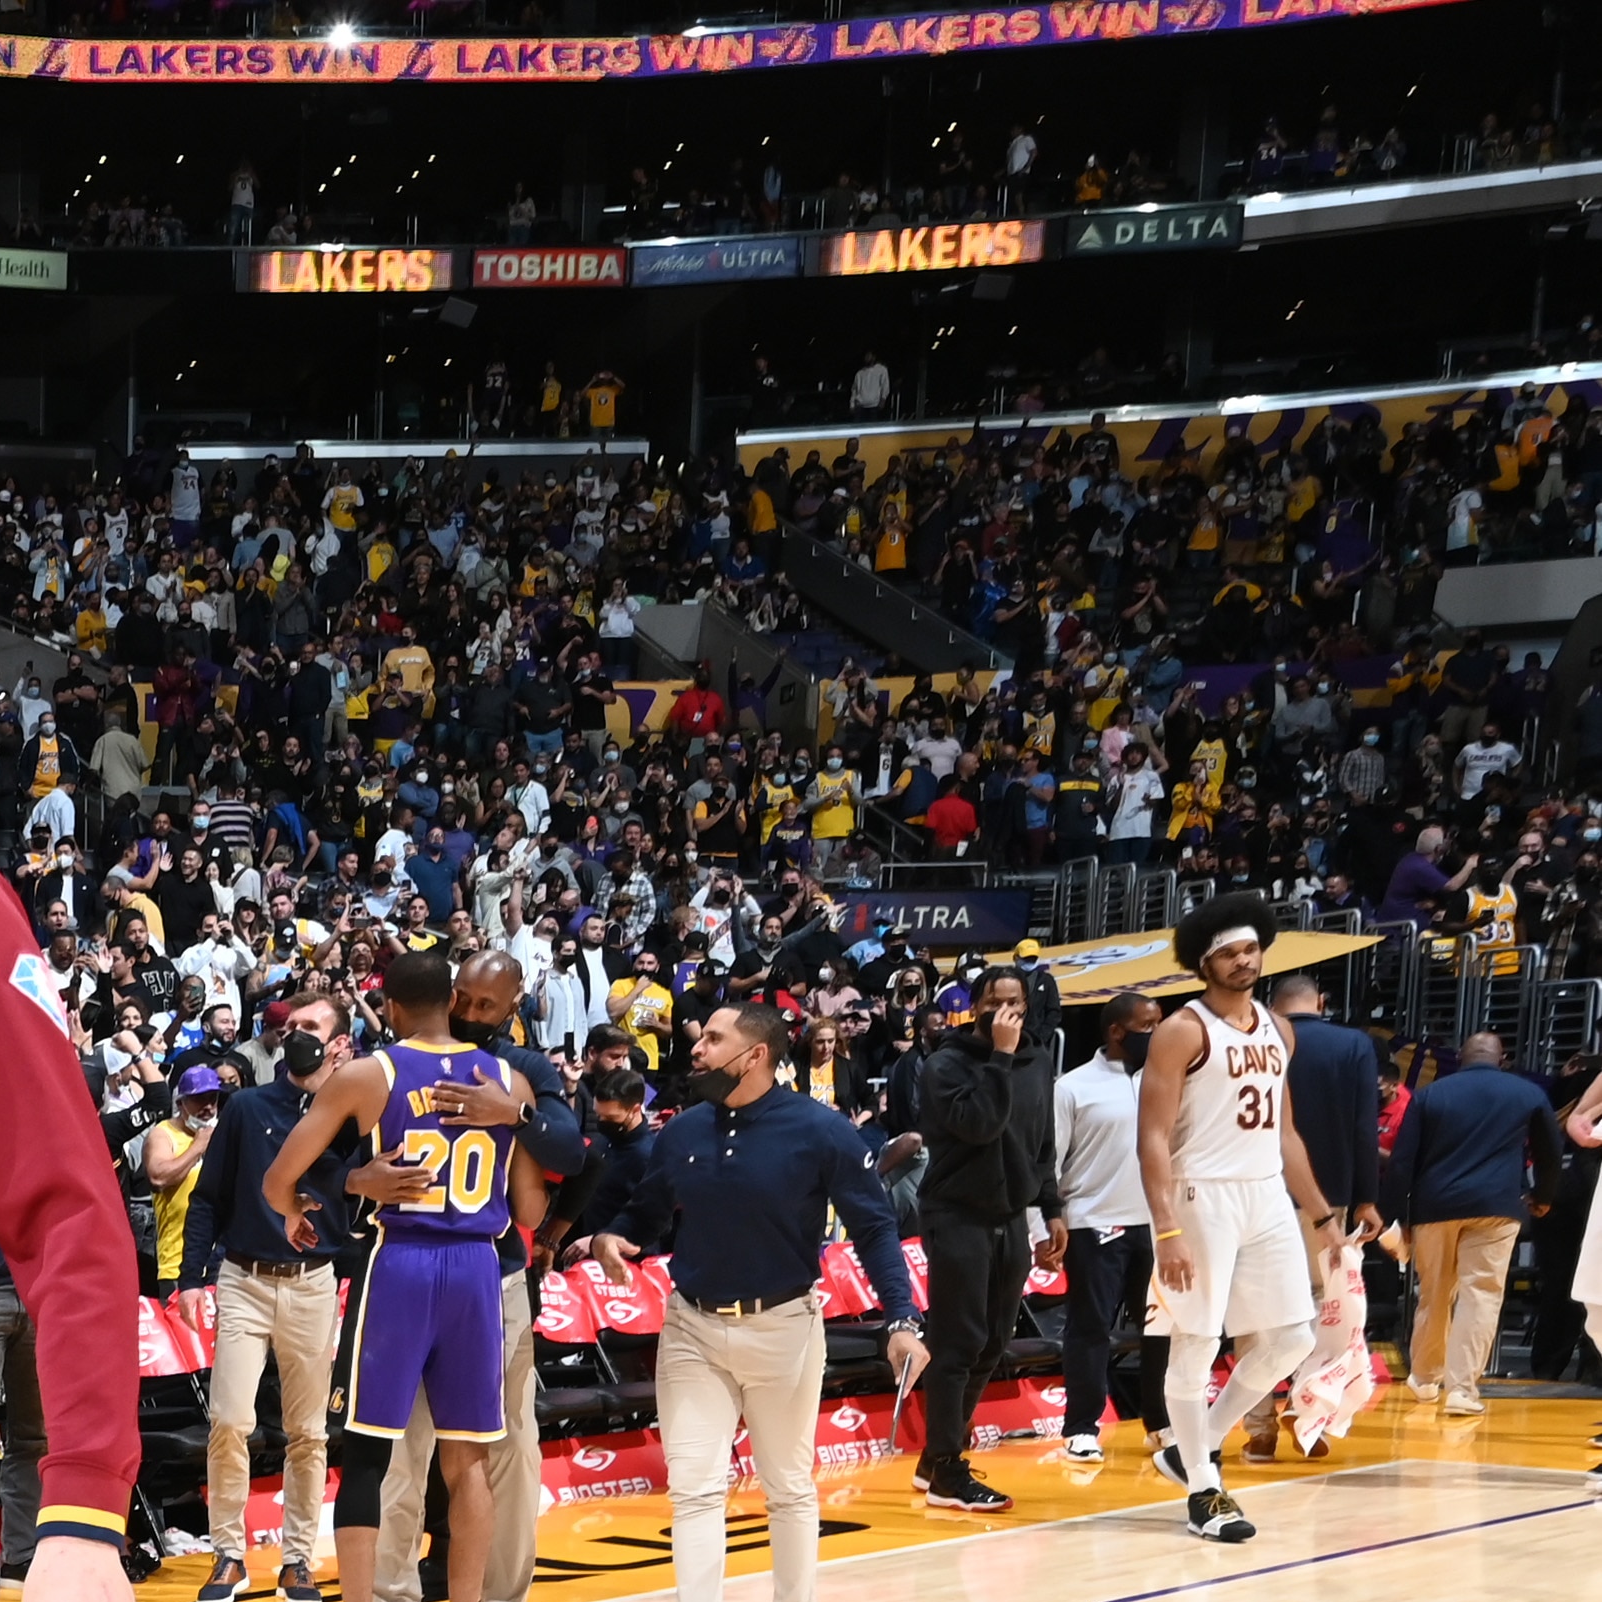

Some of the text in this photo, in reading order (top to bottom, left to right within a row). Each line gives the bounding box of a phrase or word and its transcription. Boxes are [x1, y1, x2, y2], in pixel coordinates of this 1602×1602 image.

[829, 0, 1159, 58] LAKERS WIN
[89, 44, 274, 75] LAKERS
[457, 34, 753, 76] LAKERS WIN
[1113, 215, 1229, 247] DELTA
[721, 247, 787, 271] ULTRA
[842, 222, 1023, 276] LAKERS
[270, 250, 433, 293] LAKERS
[477, 253, 621, 280] TOSHIBA
[182, 480, 196, 491] 24
[116, 528, 124, 540] 3
[516, 647, 531, 661] 24
[1035, 733, 1051, 747] 21
[44, 762, 62, 778] 24
[881, 759, 890, 771] 6
[1227, 1045, 1283, 1079] CAVS
[1236, 1085, 1277, 1130] 31
[398, 1129, 498, 1214] 20
[593, 1285, 637, 1300] STEEL
[817, 1438, 905, 1464] BIOSTEEL
[558, 1476, 653, 1502] BIOSTEEL
